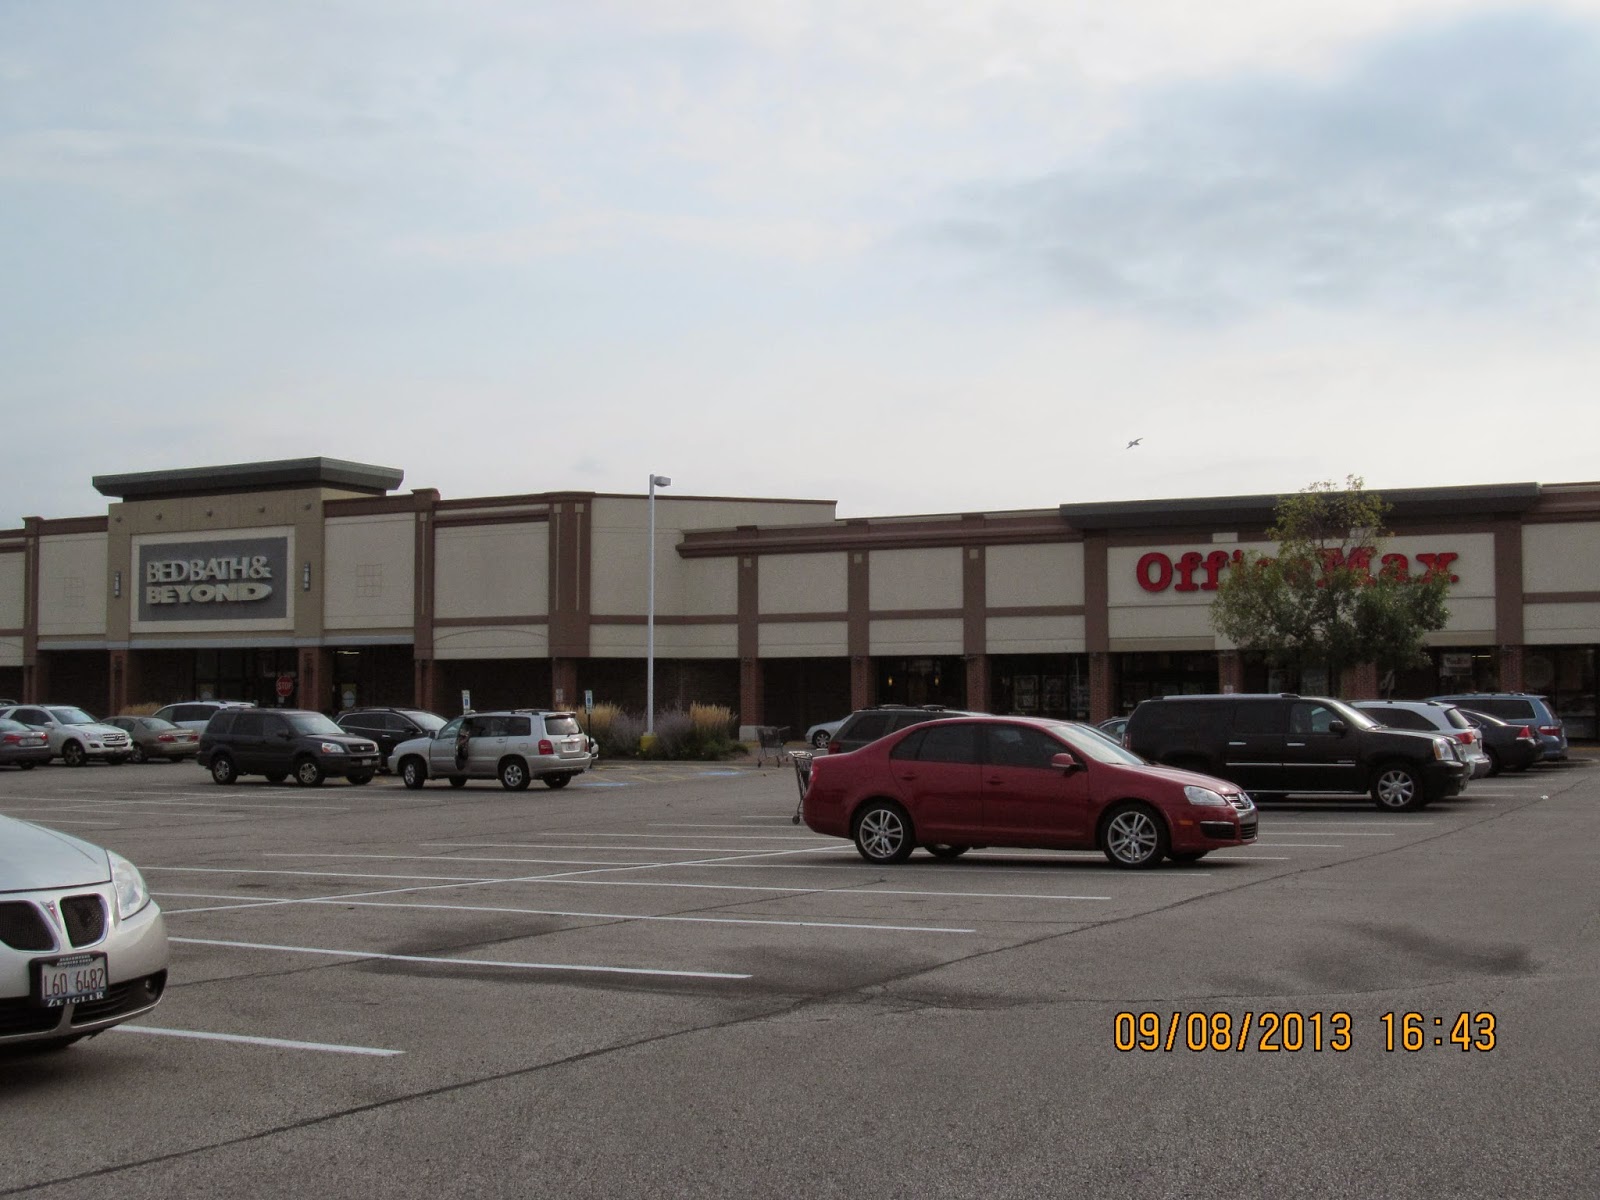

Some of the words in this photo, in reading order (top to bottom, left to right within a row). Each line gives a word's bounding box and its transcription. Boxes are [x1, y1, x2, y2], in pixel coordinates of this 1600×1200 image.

[1135, 547, 1459, 592] OffMax
[146, 582, 273, 605] BEYOND
[44, 972, 68, 997] L60
[48, 991, 104, 1008] ZEIGLER
